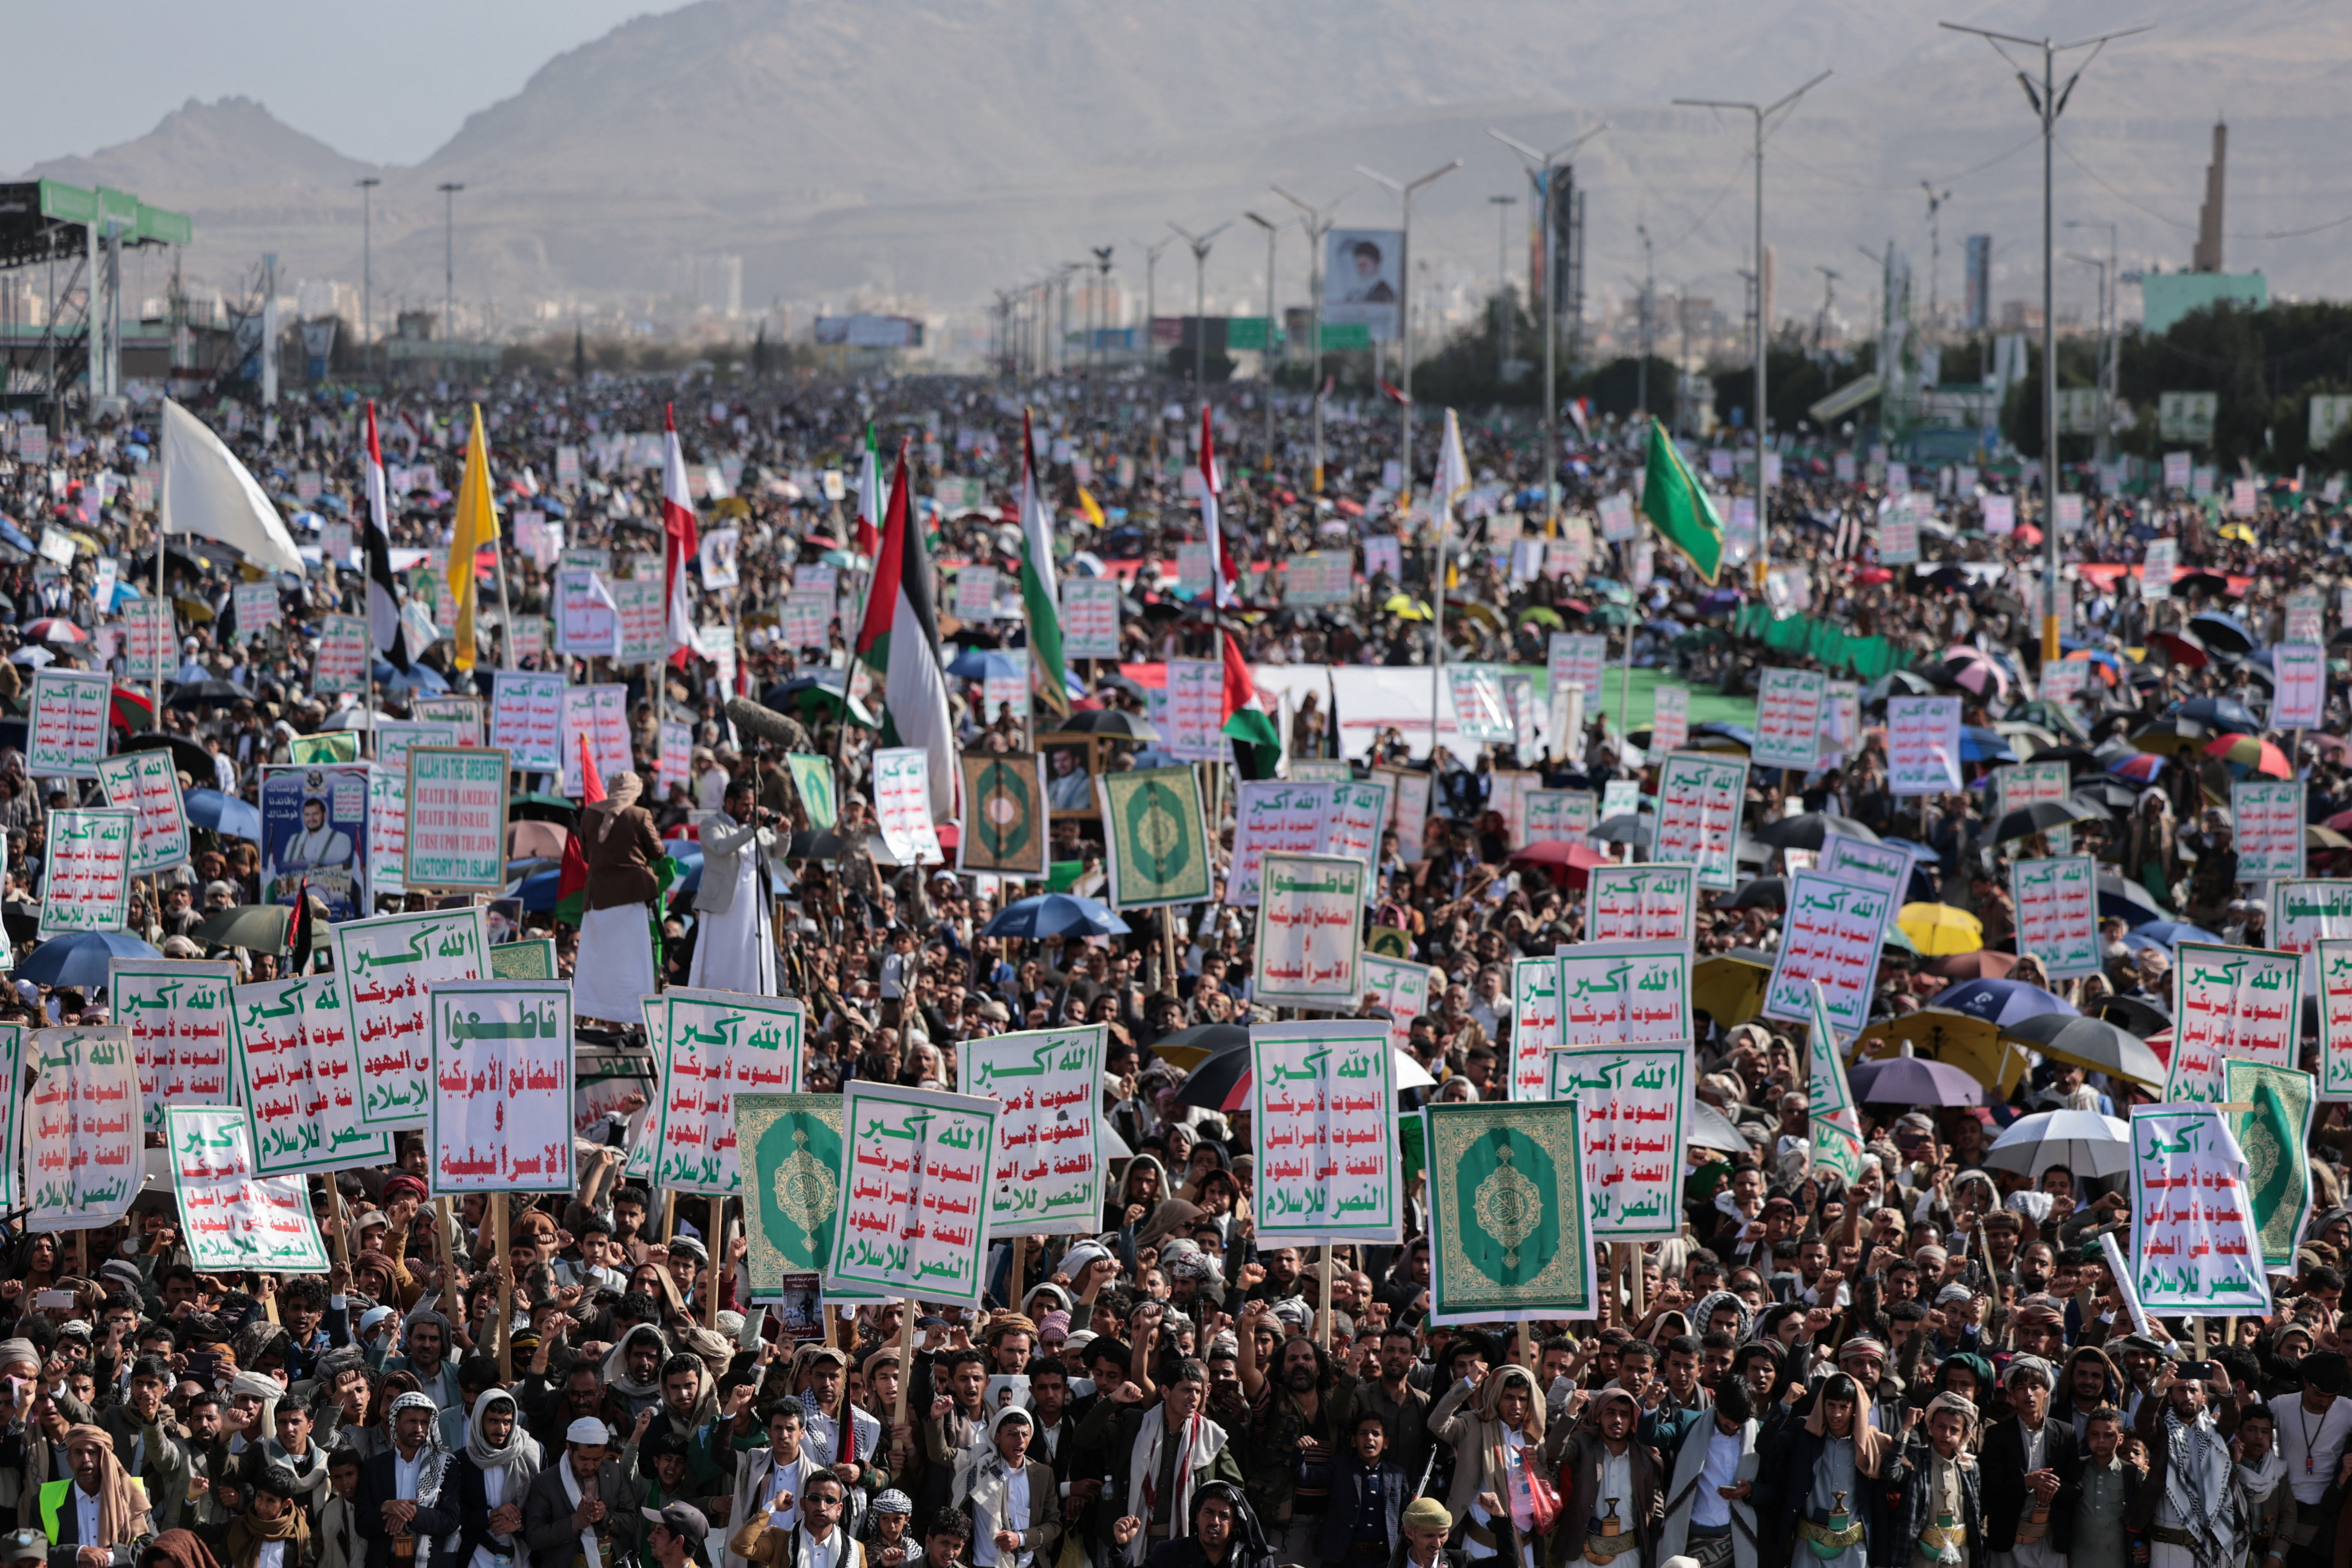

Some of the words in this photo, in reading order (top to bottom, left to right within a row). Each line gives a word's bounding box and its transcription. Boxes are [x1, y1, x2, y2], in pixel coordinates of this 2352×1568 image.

[41, 682, 78, 700] أكبر
[80, 687, 103, 700] الله
[40, 702, 72, 715] لأمريكا
[75, 707, 101, 718] الموت
[35, 749, 66, 766] للإسلام
[145, 755, 168, 775] الله
[419, 757, 440, 779] ALLAH
[442, 758, 448, 779] IS
[451, 758, 463, 780] THE
[466, 759, 501, 781] GREATEST
[109, 759, 139, 787] أكبر
[143, 783, 172, 797] الموت
[418, 788, 445, 804] DEATH
[449, 789, 458, 804] TO
[461, 789, 497, 806] AMERICA
[56, 818, 100, 844] أكبر
[101, 821, 127, 840] الله
[417, 810, 444, 826] DEATH
[448, 811, 458, 826] TO
[460, 812, 490, 828] ISRAEL
[54, 846, 92, 860] لأمريكا
[416, 834, 438, 850] CURSE
[440, 835, 459, 850] UPON
[462, 836, 476, 851] THE
[478, 836, 496, 852] JEWS
[95, 849, 125, 863] الموت
[415, 858, 453, 876] VICTORY
[456, 859, 467, 877] TO
[470, 859, 496, 878] ISLAM
[1270, 870, 1354, 896] قاطعوا
[1599, 871, 1652, 898] أكبر
[1653, 874, 1684, 894] الله
[1797, 887, 1851, 914] أكبر
[1850, 895, 1881, 919] الله
[47, 905, 84, 927] للإسلام
[1268, 903, 1312, 928] الأمريكية
[1314, 906, 1353, 929] البضائع
[1794, 915, 1837, 936] لأمريكا
[439, 926, 474, 957] الله
[1304, 935, 1311, 951] و
[1840, 927, 1876, 944] الموت
[351, 922, 440, 978] أكبر
[1266, 959, 1349, 983] الإسرائيلية
[1569, 961, 1634, 1001] أكبر
[1638, 965, 1678, 991] الله
[2186, 956, 2249, 990] أكبر
[2250, 963, 2292, 990] الله
[121, 980, 184, 1017] أكبر
[186, 985, 225, 1009] الله
[354, 974, 417, 1004] لأمريكا
[242, 980, 308, 1029] أكبر
[1570, 1003, 1626, 1026] لأمريكا
[1631, 1004, 1679, 1025] الموت
[2186, 991, 2237, 1016] لأمريكا
[2241, 1003, 2288, 1021] الموت
[180, 1022, 225, 1040] الموت
[360, 1011, 424, 1042] لإسرائيل
[445, 1001, 556, 1050] قاطعوا
[675, 1011, 746, 1051] أكبر
[748, 1021, 792, 1050] الله
[2183, 1021, 2234, 1051] لإسرائيل
[89, 1036, 124, 1065] الله
[245, 1023, 308, 1054] لأمريكا
[39, 1032, 85, 1078] أكبر
[364, 1050, 411, 1077] اليهود
[674, 1054, 732, 1081] لأمريكا
[974, 1037, 1065, 1089] أكبر
[1059, 1040, 1093, 1071] الله
[1266, 1045, 1333, 1089] أكبر
[1338, 1050, 1380, 1078] الله
[163, 1077, 184, 1097] على
[190, 1076, 225, 1093] اللعنة
[252, 1060, 313, 1091] لإسرائيل
[439, 1055, 502, 1099] الأمريكية
[508, 1060, 564, 1098] البضائع
[738, 1065, 789, 1087] الموت
[1558, 1057, 1630, 1098] أكبر
[1631, 1061, 1676, 1090] الله
[83, 1081, 129, 1105] الموت
[305, 1092, 328, 1116] على
[671, 1088, 730, 1119] لإسرائيل
[1040, 1084, 1089, 1110] الموت
[1266, 1091, 1325, 1116] لأمريكا
[1331, 1091, 1381, 1115] الموت
[256, 1095, 299, 1122] اليهود
[495, 1101, 504, 1131] و
[1623, 1103, 1673, 1124] الموت
[83, 1113, 130, 1137] الموت
[179, 1116, 245, 1155] أكبر
[667, 1125, 708, 1148] اليهود
[859, 1110, 937, 1144] أكبر
[937, 1120, 984, 1150] الله
[1266, 1125, 1326, 1149] لإسرائيل
[1332, 1124, 1383, 1148] الموت
[262, 1123, 320, 1162] للإسلام
[712, 1128, 737, 1151] على
[2142, 1118, 2205, 1164] أكبر
[38, 1148, 67, 1171] اليهود
[95, 1146, 130, 1165] اللعنة
[181, 1153, 245, 1181] لأمريكا
[440, 1143, 567, 1182] الإسرائيلية
[857, 1145, 921, 1173] لأمريكا
[1054, 1154, 1092, 1174] اللعنة
[1345, 1156, 1383, 1175] اللعنة
[661, 1153, 722, 1189] للإسلام
[926, 1161, 980, 1184] الموت
[1266, 1158, 1309, 1182] اليهود
[1315, 1158, 1339, 1181] على
[1631, 1162, 1669, 1181] اللعنة
[33, 1181, 76, 1214] للإسلام
[79, 1177, 127, 1211] النصر
[187, 1184, 250, 1209] لإسرائيل
[854, 1177, 918, 1206] لإسرائيل
[923, 1193, 977, 1215] الموت
[1039, 1184, 1091, 1214] النصر
[1266, 1187, 1326, 1221] للإسلام
[1331, 1184, 1384, 1220] النصر
[1615, 1189, 1667, 1225] النصر
[192, 1214, 235, 1234] اليهود
[270, 1215, 307, 1233] اللعنة
[850, 1211, 895, 1235] اليهود
[900, 1220, 926, 1240] على
[932, 1221, 973, 1247] اللعنة
[267, 1238, 315, 1261] النصر
[2143, 1236, 2182, 1259] اليهود
[2216, 1235, 2252, 1255] اللعنة
[844, 1238, 909, 1279] للإسلام
[912, 1252, 969, 1280] النصر
[2142, 1267, 2200, 1301] للإسلام
[2206, 1264, 2255, 1300] النصر
